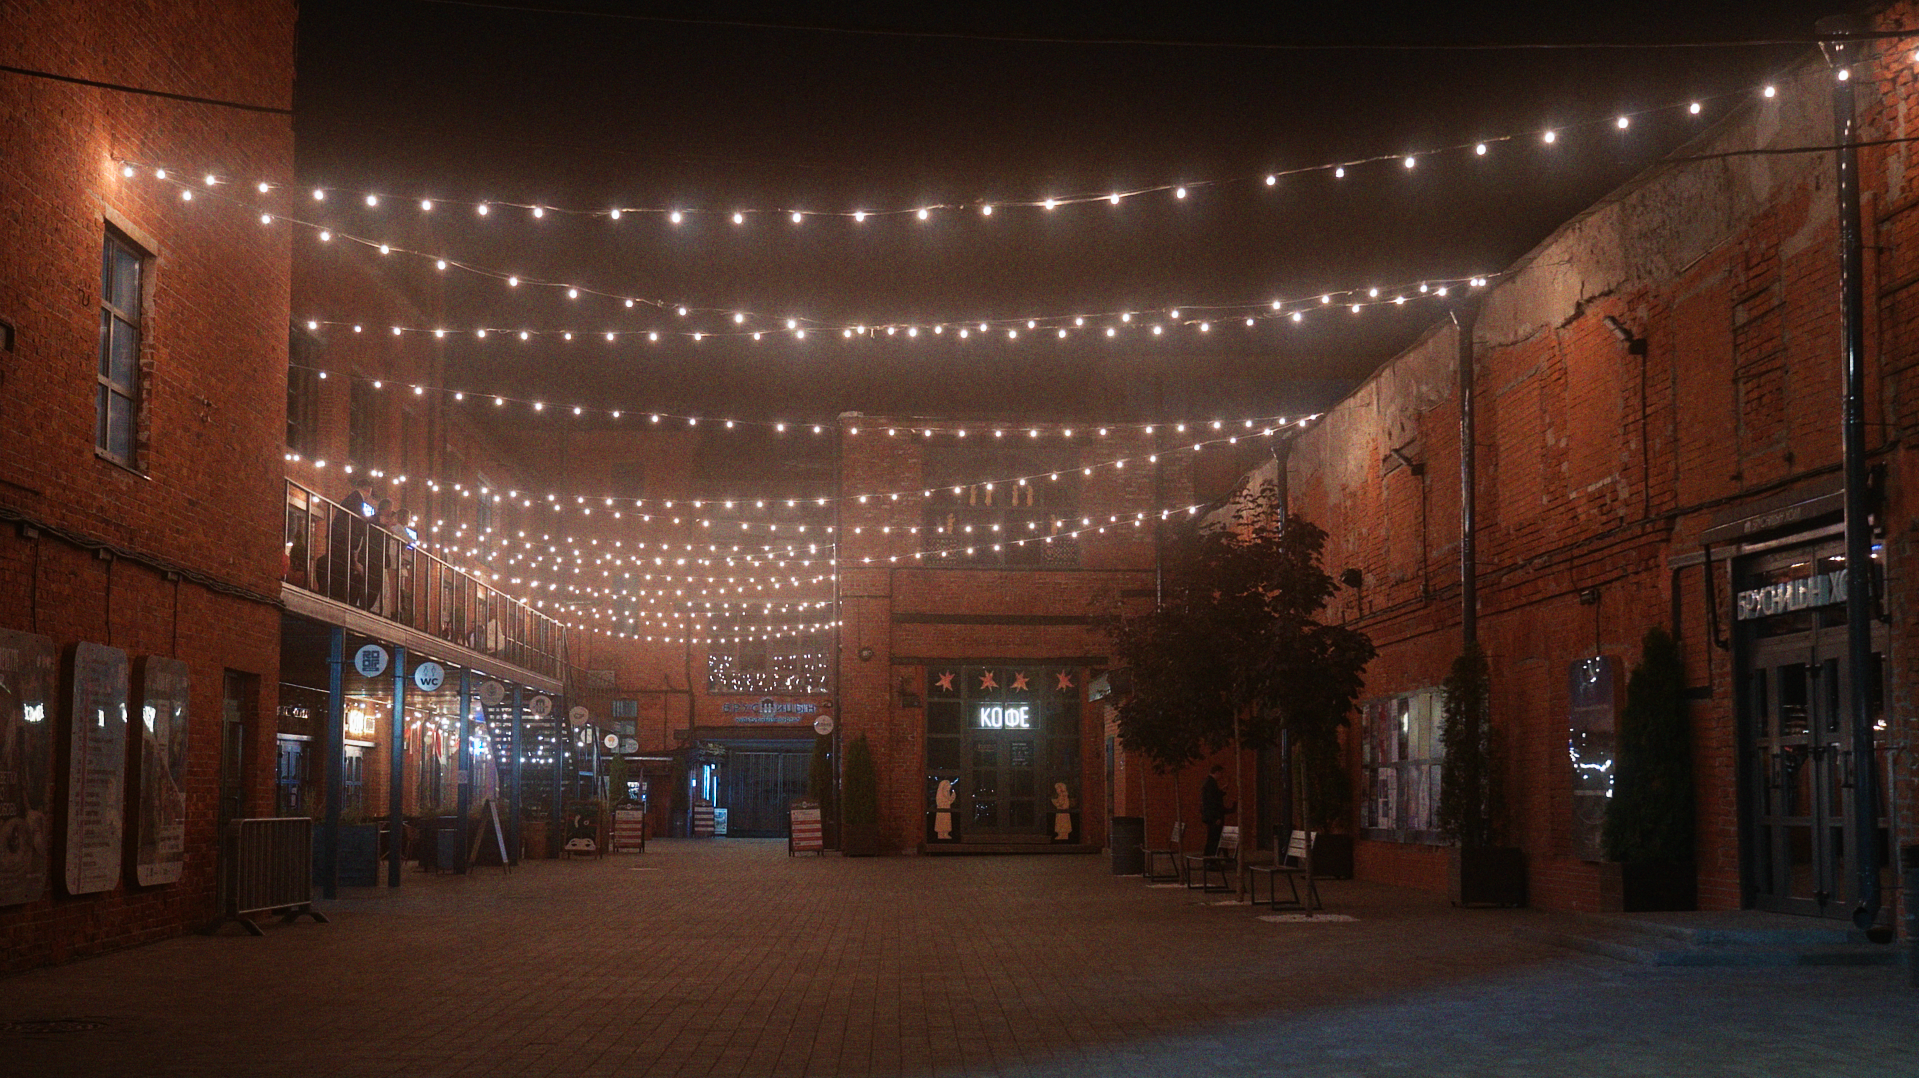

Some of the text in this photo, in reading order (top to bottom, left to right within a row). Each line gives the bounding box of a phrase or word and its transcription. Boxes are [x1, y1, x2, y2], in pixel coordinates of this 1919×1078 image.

[1738, 575, 1829, 620] БРУСНИЦЫН
[420, 678, 439, 686] WC
[980, 706, 1030, 728] КОФЕ
